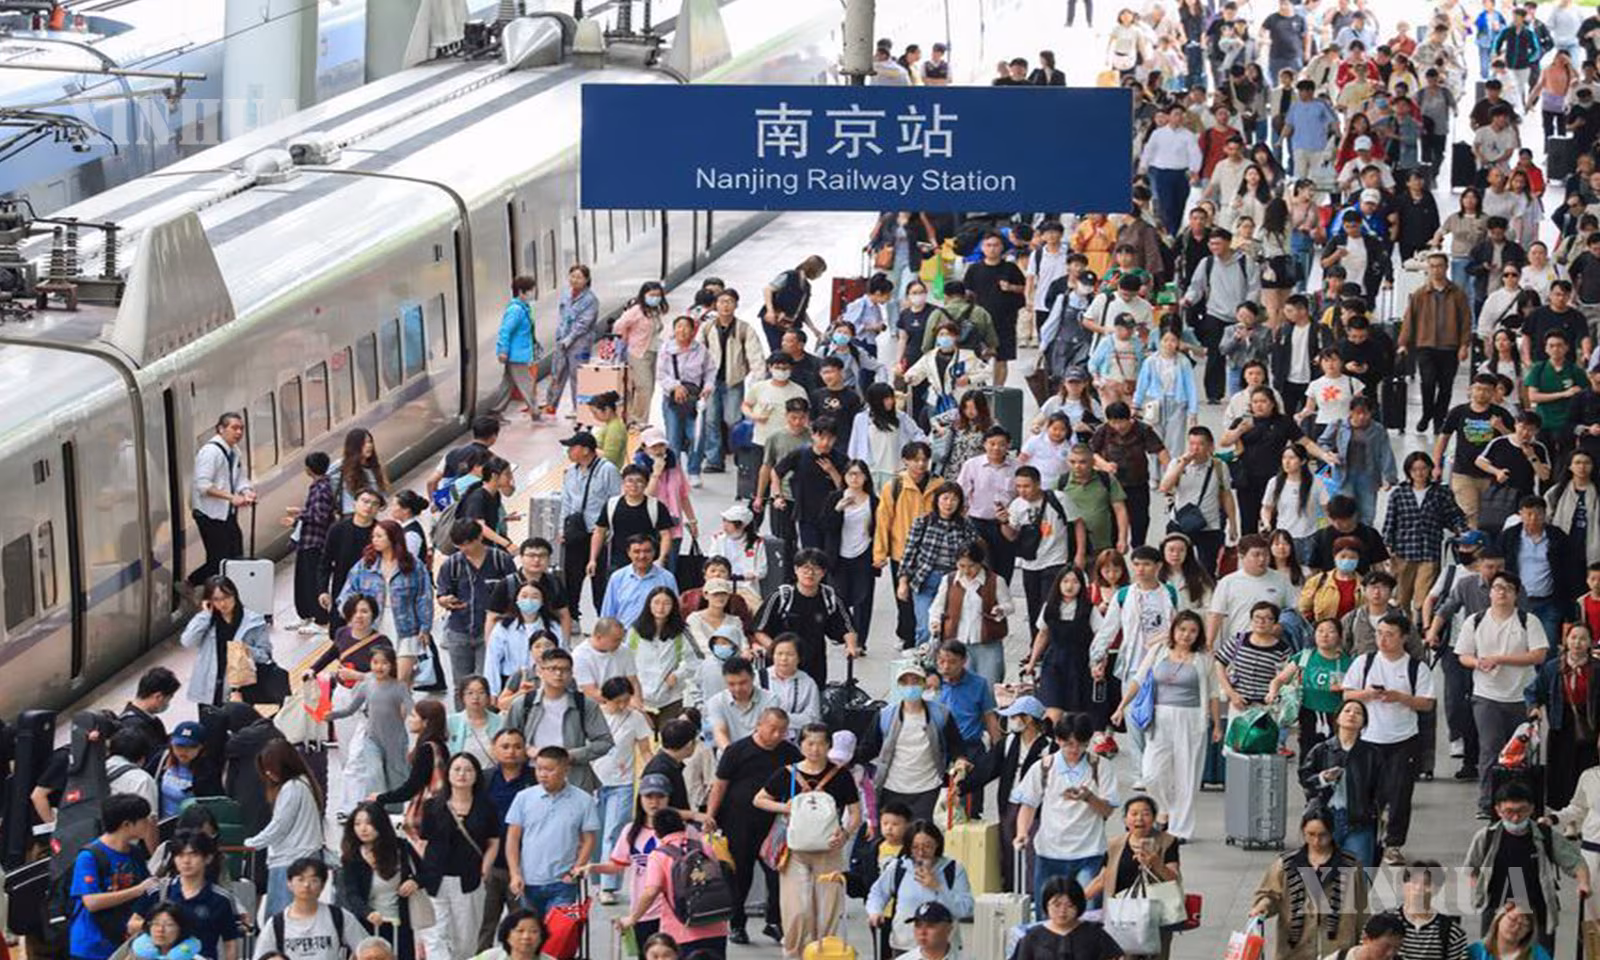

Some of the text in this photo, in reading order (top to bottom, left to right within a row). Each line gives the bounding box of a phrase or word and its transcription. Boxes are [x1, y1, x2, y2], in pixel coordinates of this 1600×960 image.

[754, 102, 958, 158] 南京站
[696, 168, 1016, 195] Nanjing Railway Station
